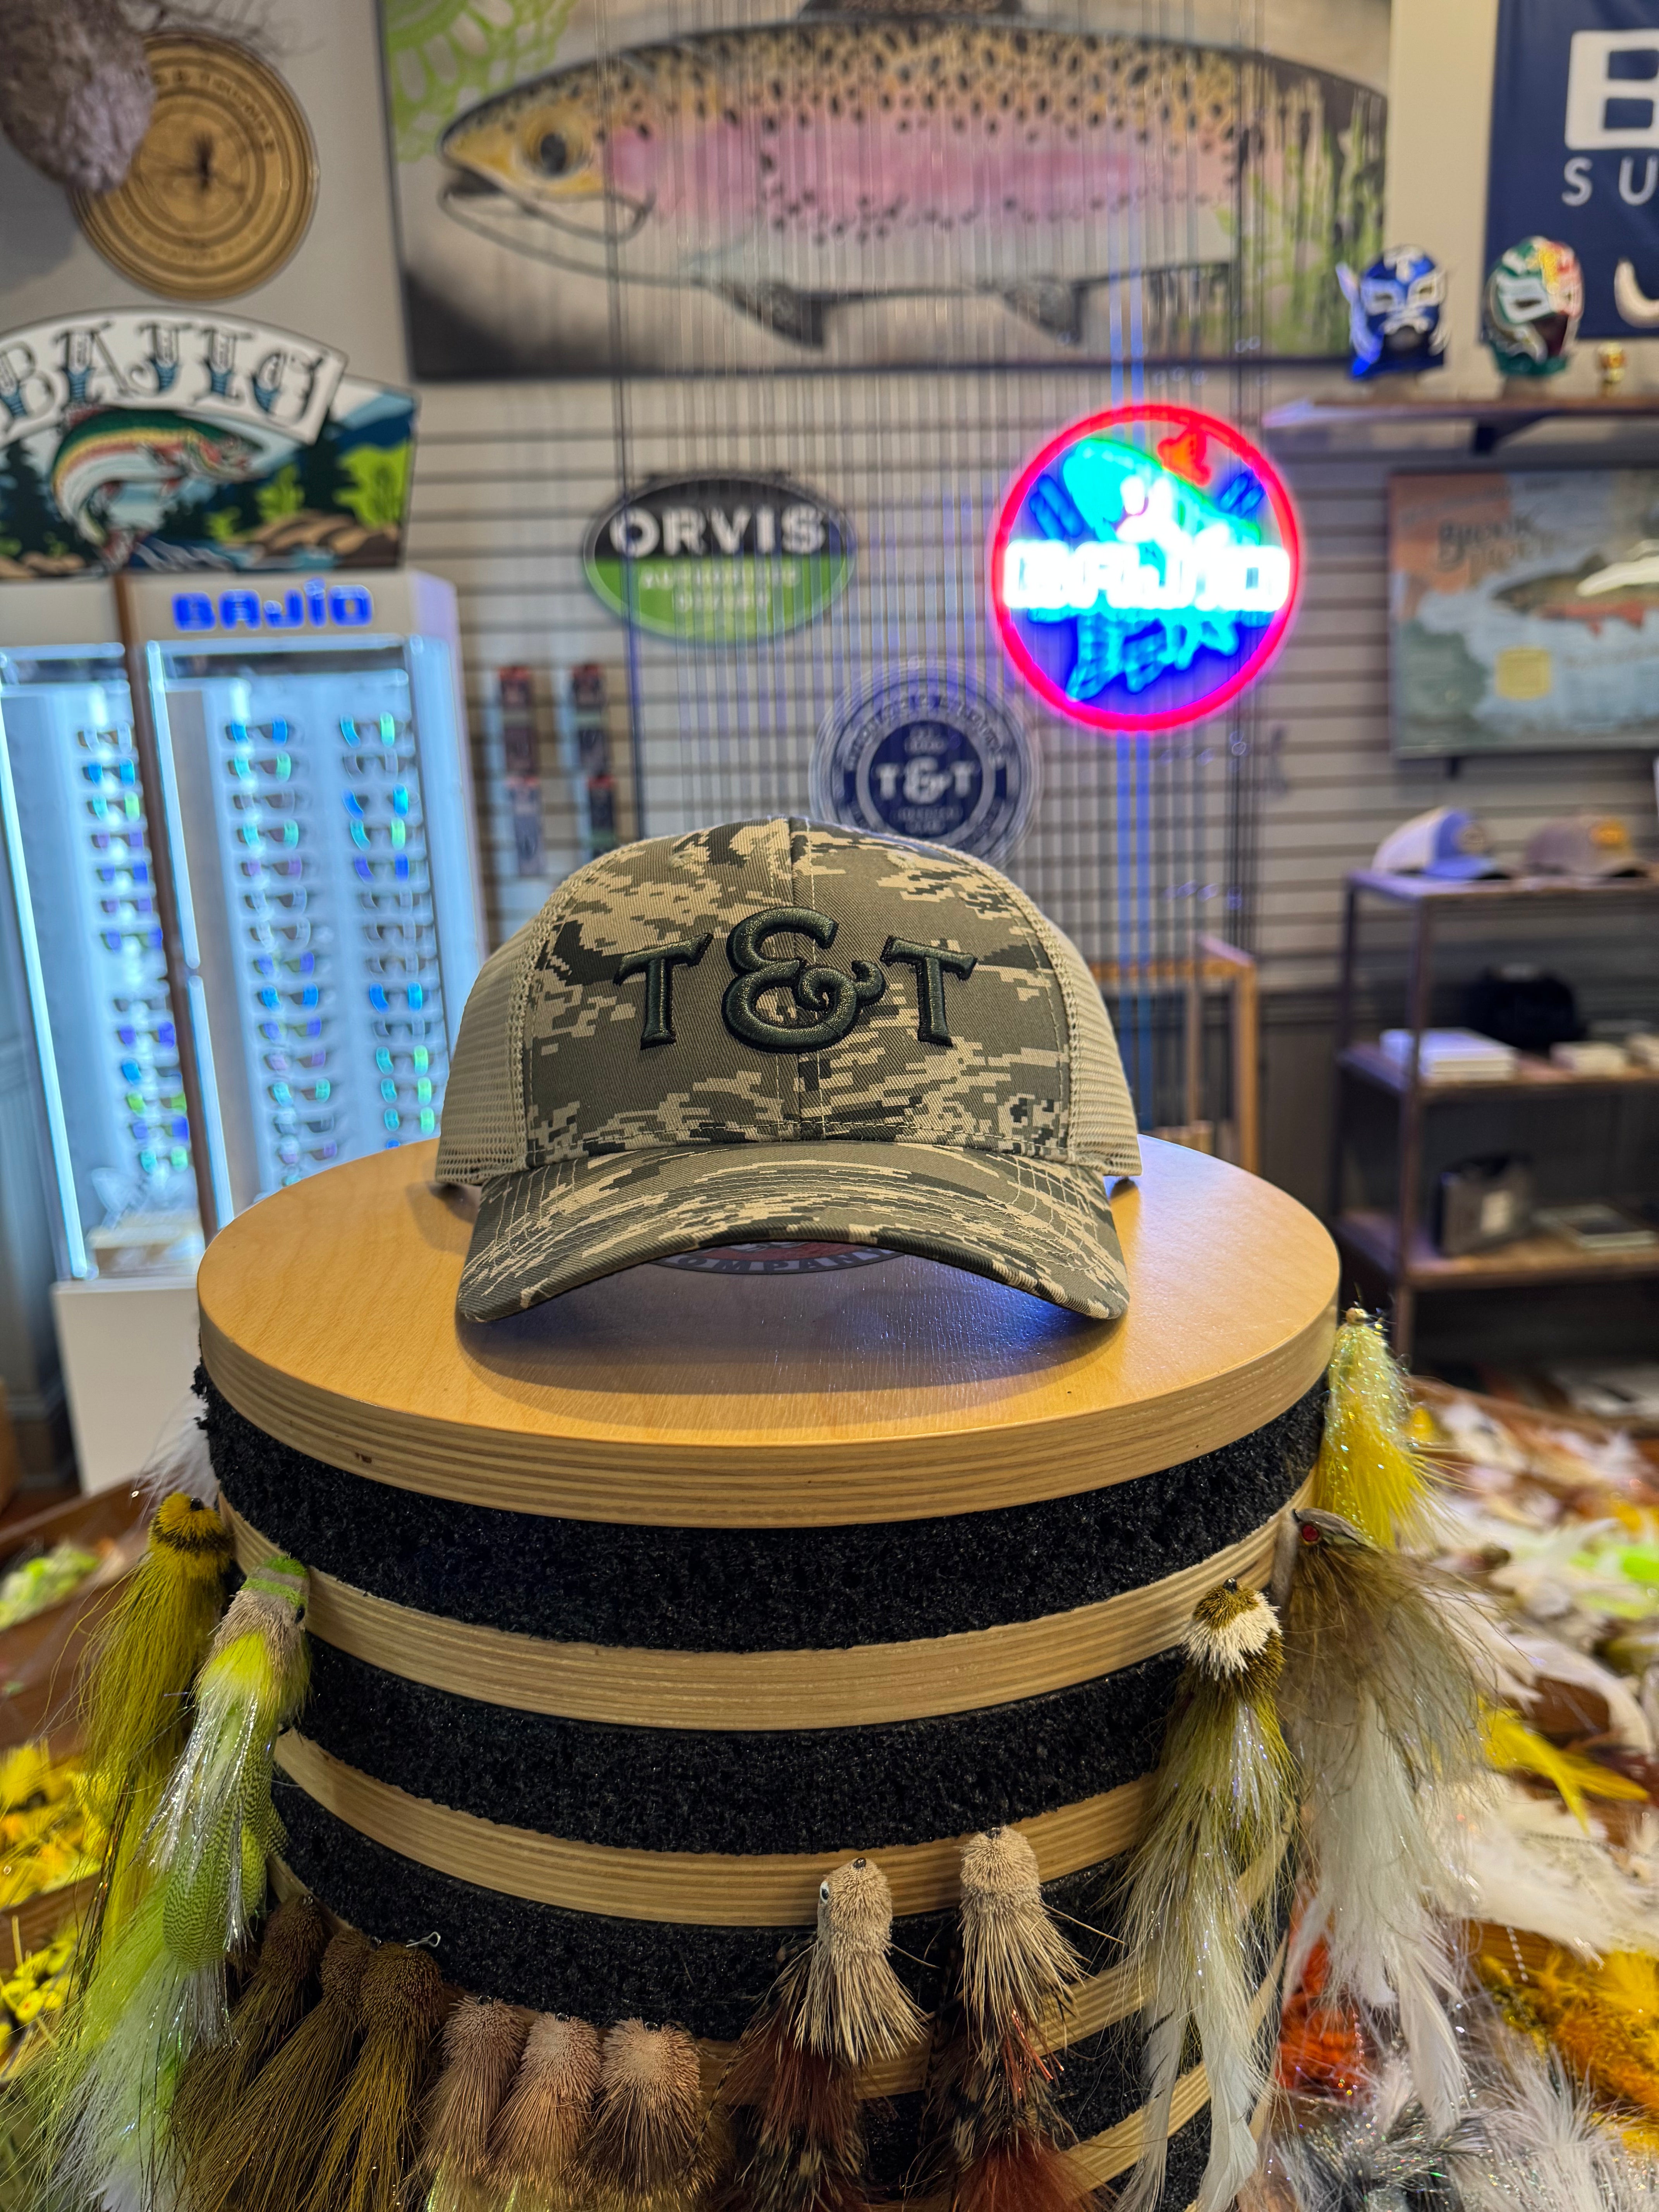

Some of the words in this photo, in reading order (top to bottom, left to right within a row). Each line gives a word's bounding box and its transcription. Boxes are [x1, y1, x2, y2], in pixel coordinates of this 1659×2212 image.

[609, 504, 826, 558] ORVIS
[875, 756, 981, 804] T&T
[613, 905, 977, 1054] T&T
[663, 1244, 891, 1271] OMPANY
